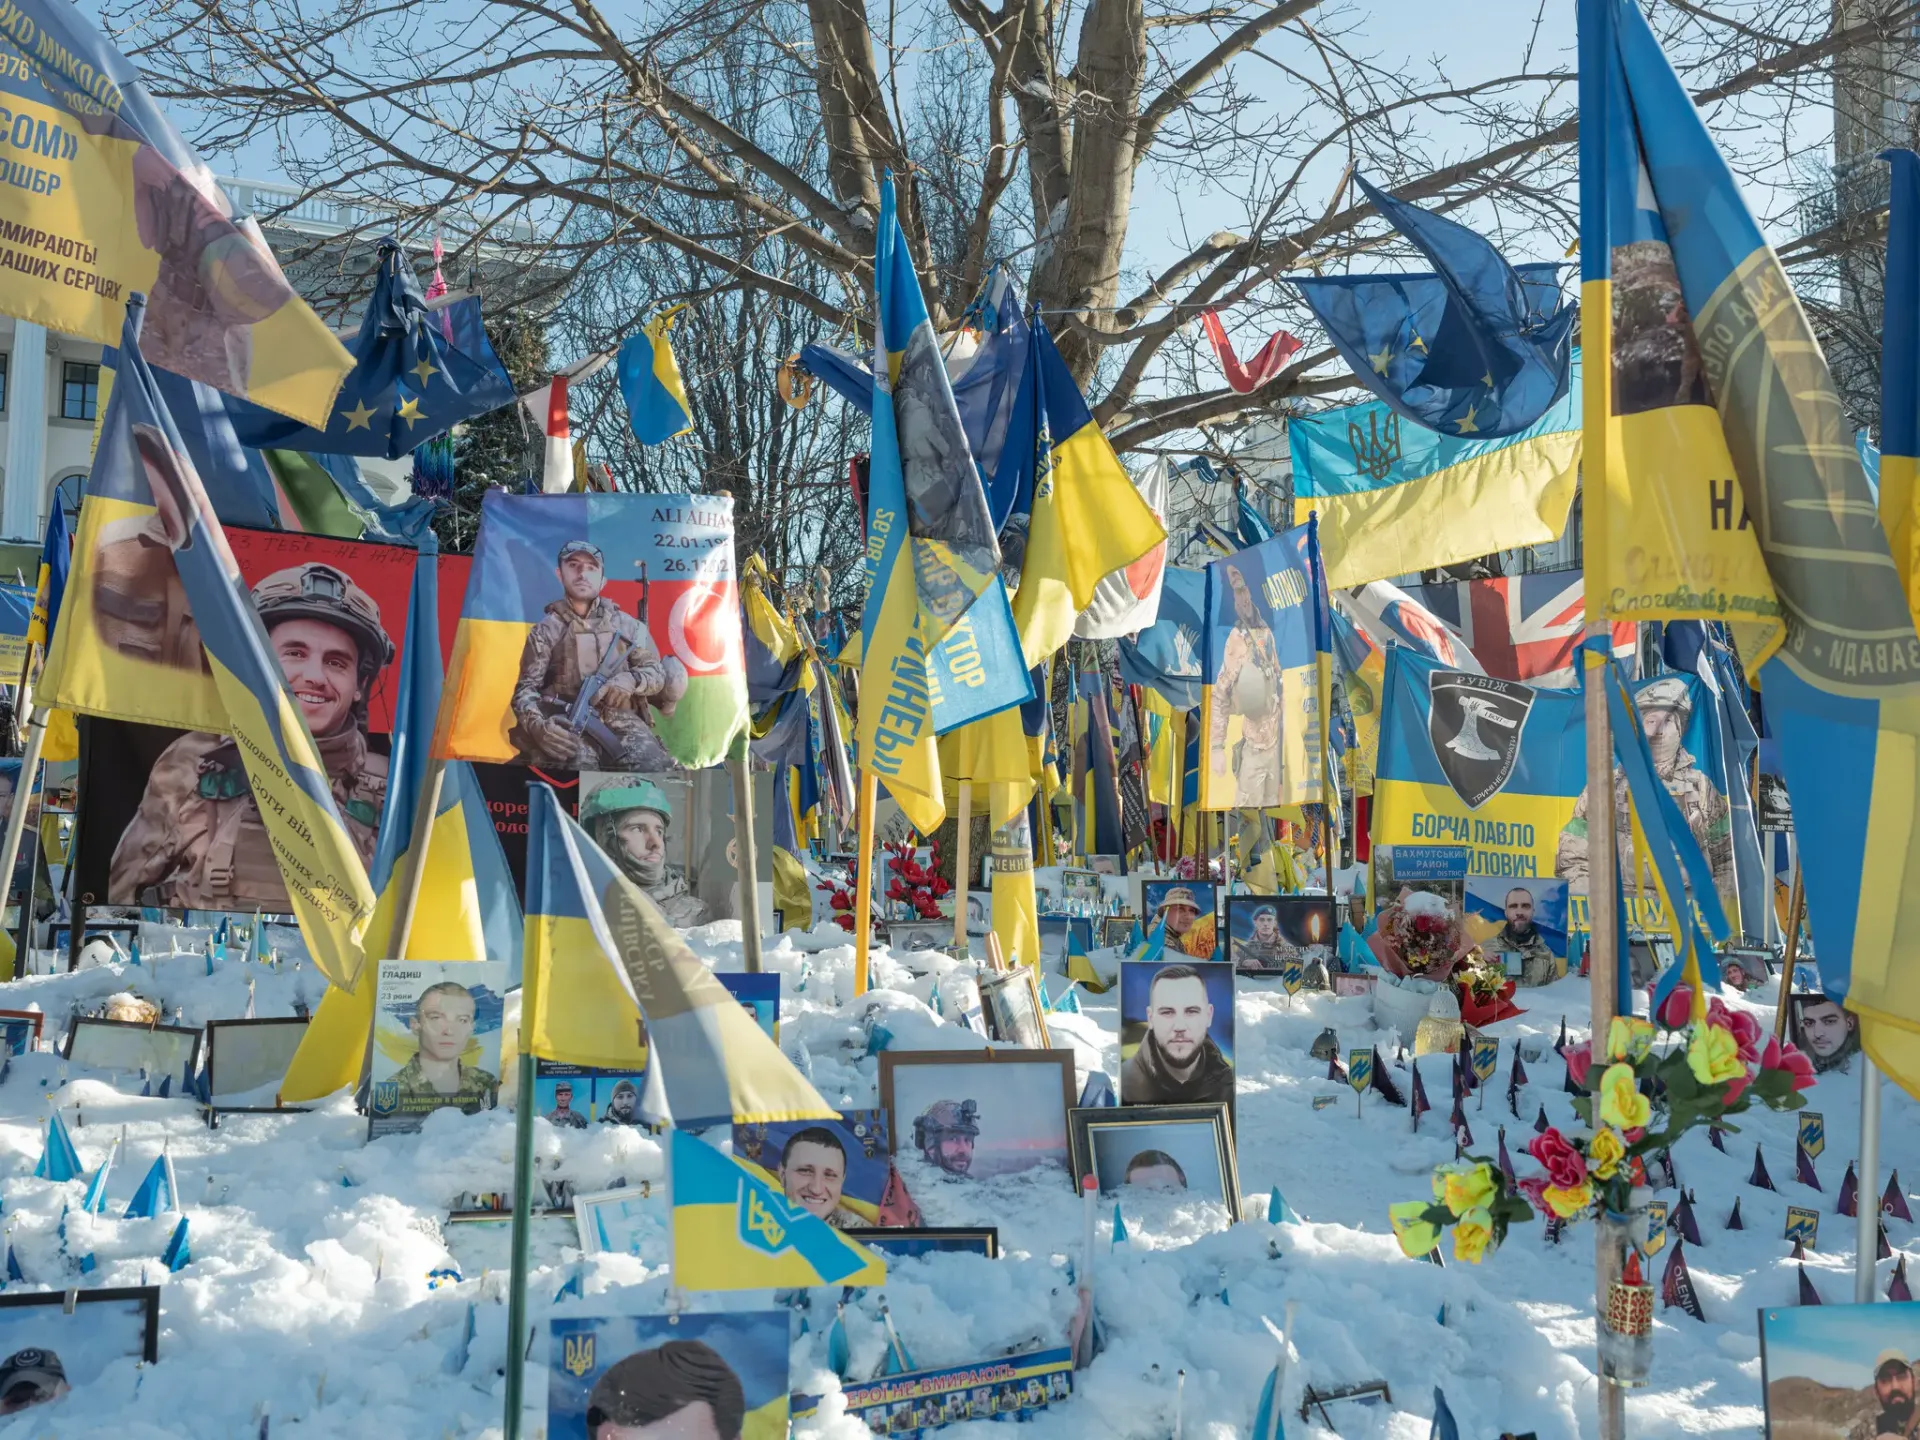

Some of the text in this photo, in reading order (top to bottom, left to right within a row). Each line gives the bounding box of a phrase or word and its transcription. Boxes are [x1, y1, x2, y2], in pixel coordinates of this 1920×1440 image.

[63, 267, 122, 301] СЕРЦЯХ
[651, 508, 682, 523] ALI
[1456, 675, 1509, 693] РУБІЖ
[1493, 774, 1504, 788] НЕ
[251, 773, 287, 816] Боги
[1412, 812, 1535, 848] БОРЧА ПАВЛО
[382, 971, 421, 979] ГЛАДИШ
[892, 1380, 916, 1399] НЕ
[921, 1363, 1017, 1394] ВМИРАЮТЬ
